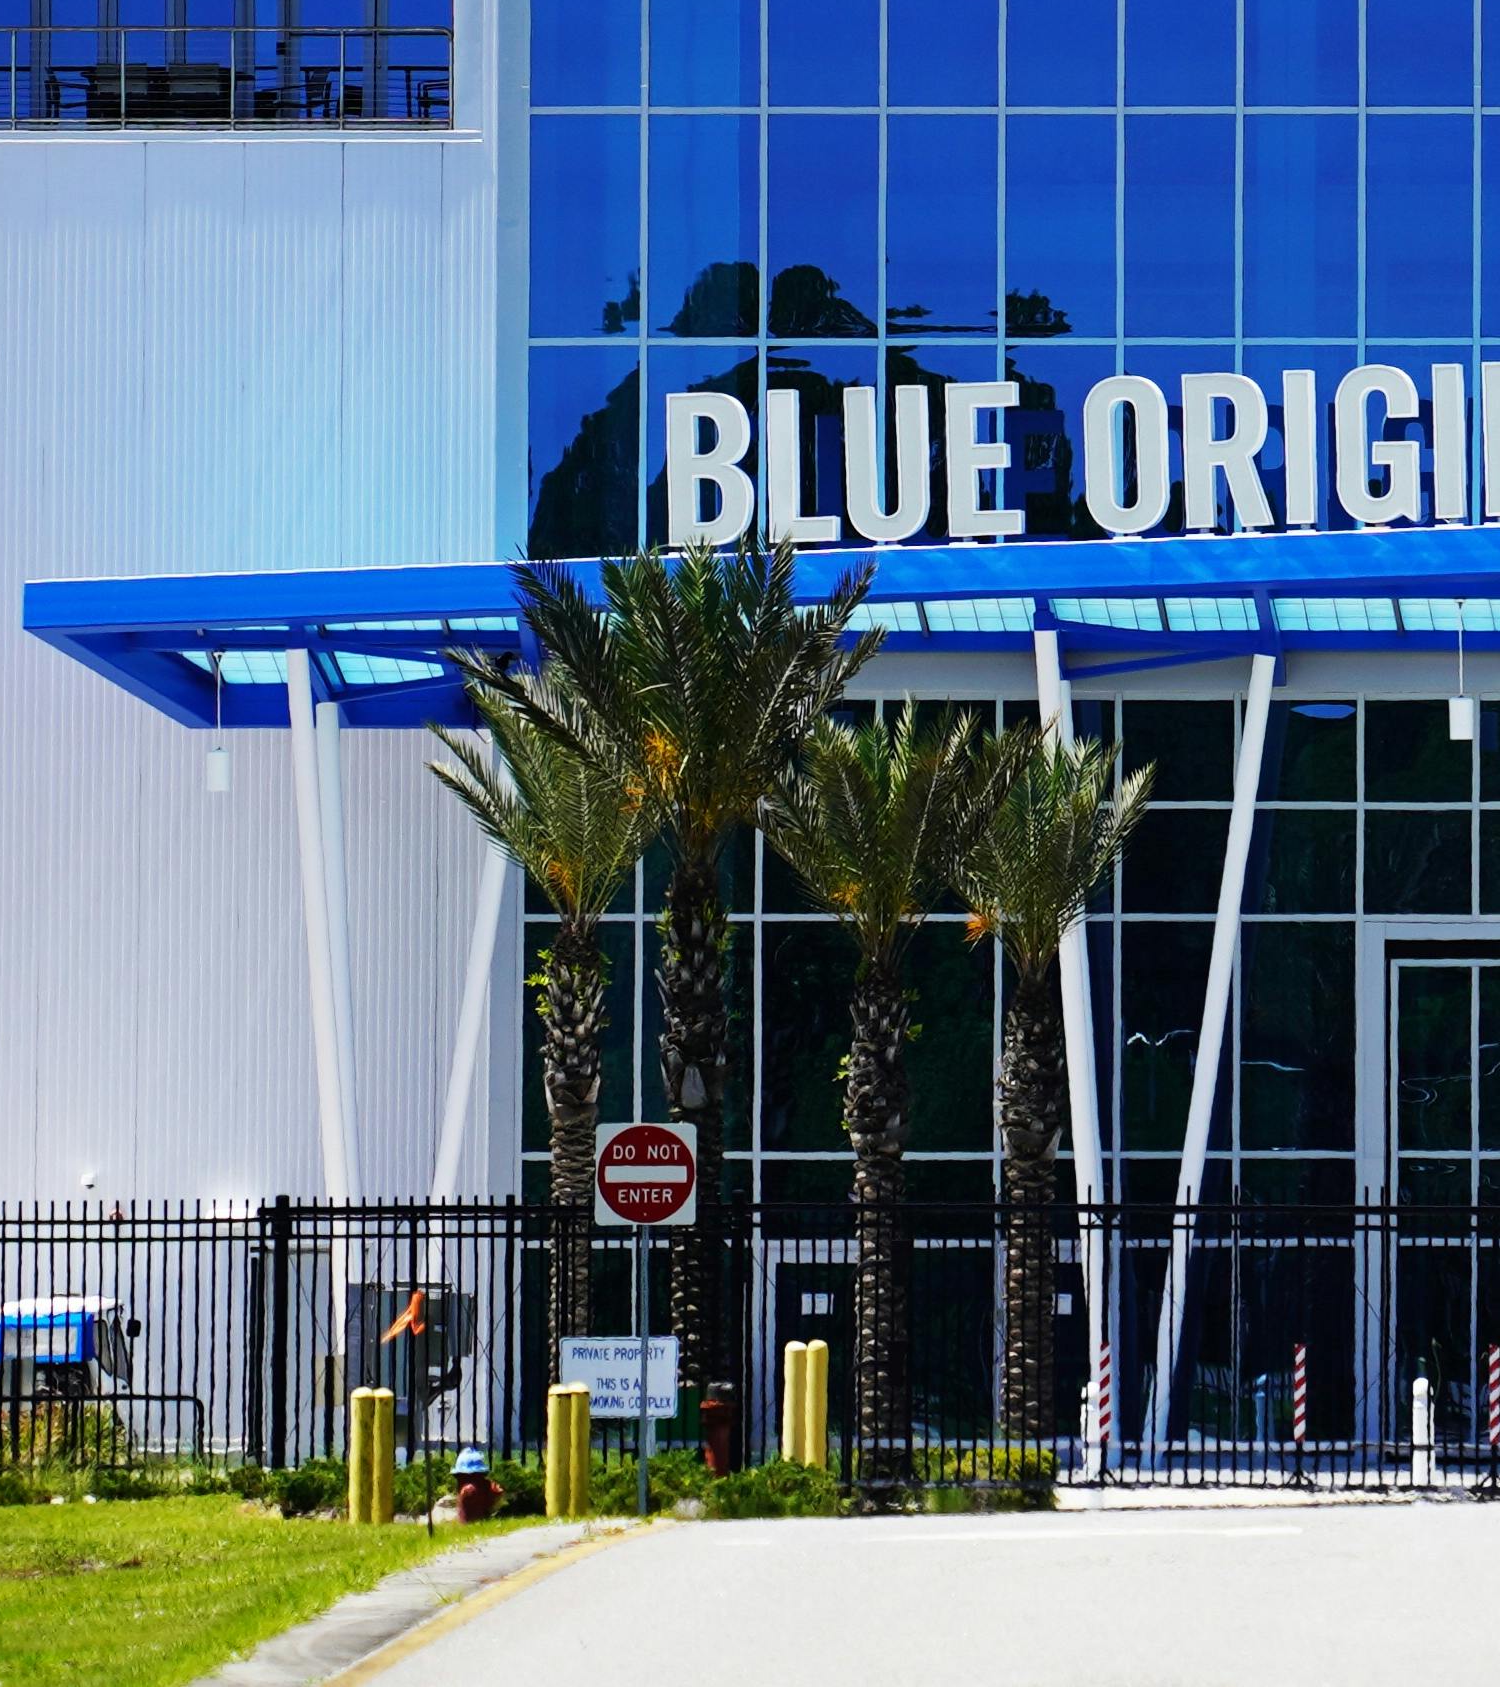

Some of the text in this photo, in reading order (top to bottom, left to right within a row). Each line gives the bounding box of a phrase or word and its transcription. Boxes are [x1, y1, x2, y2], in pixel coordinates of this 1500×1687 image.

[666, 381, 1026, 547] BLUE
[613, 1144, 680, 1161] DO NOT
[618, 1188, 673, 1204] ENTER
[572, 1347, 666, 1361] PRIVATE PROPRTY
[597, 1378, 642, 1391] THIS IS A
[589, 1396, 671, 1410] MOKING COPLEX
